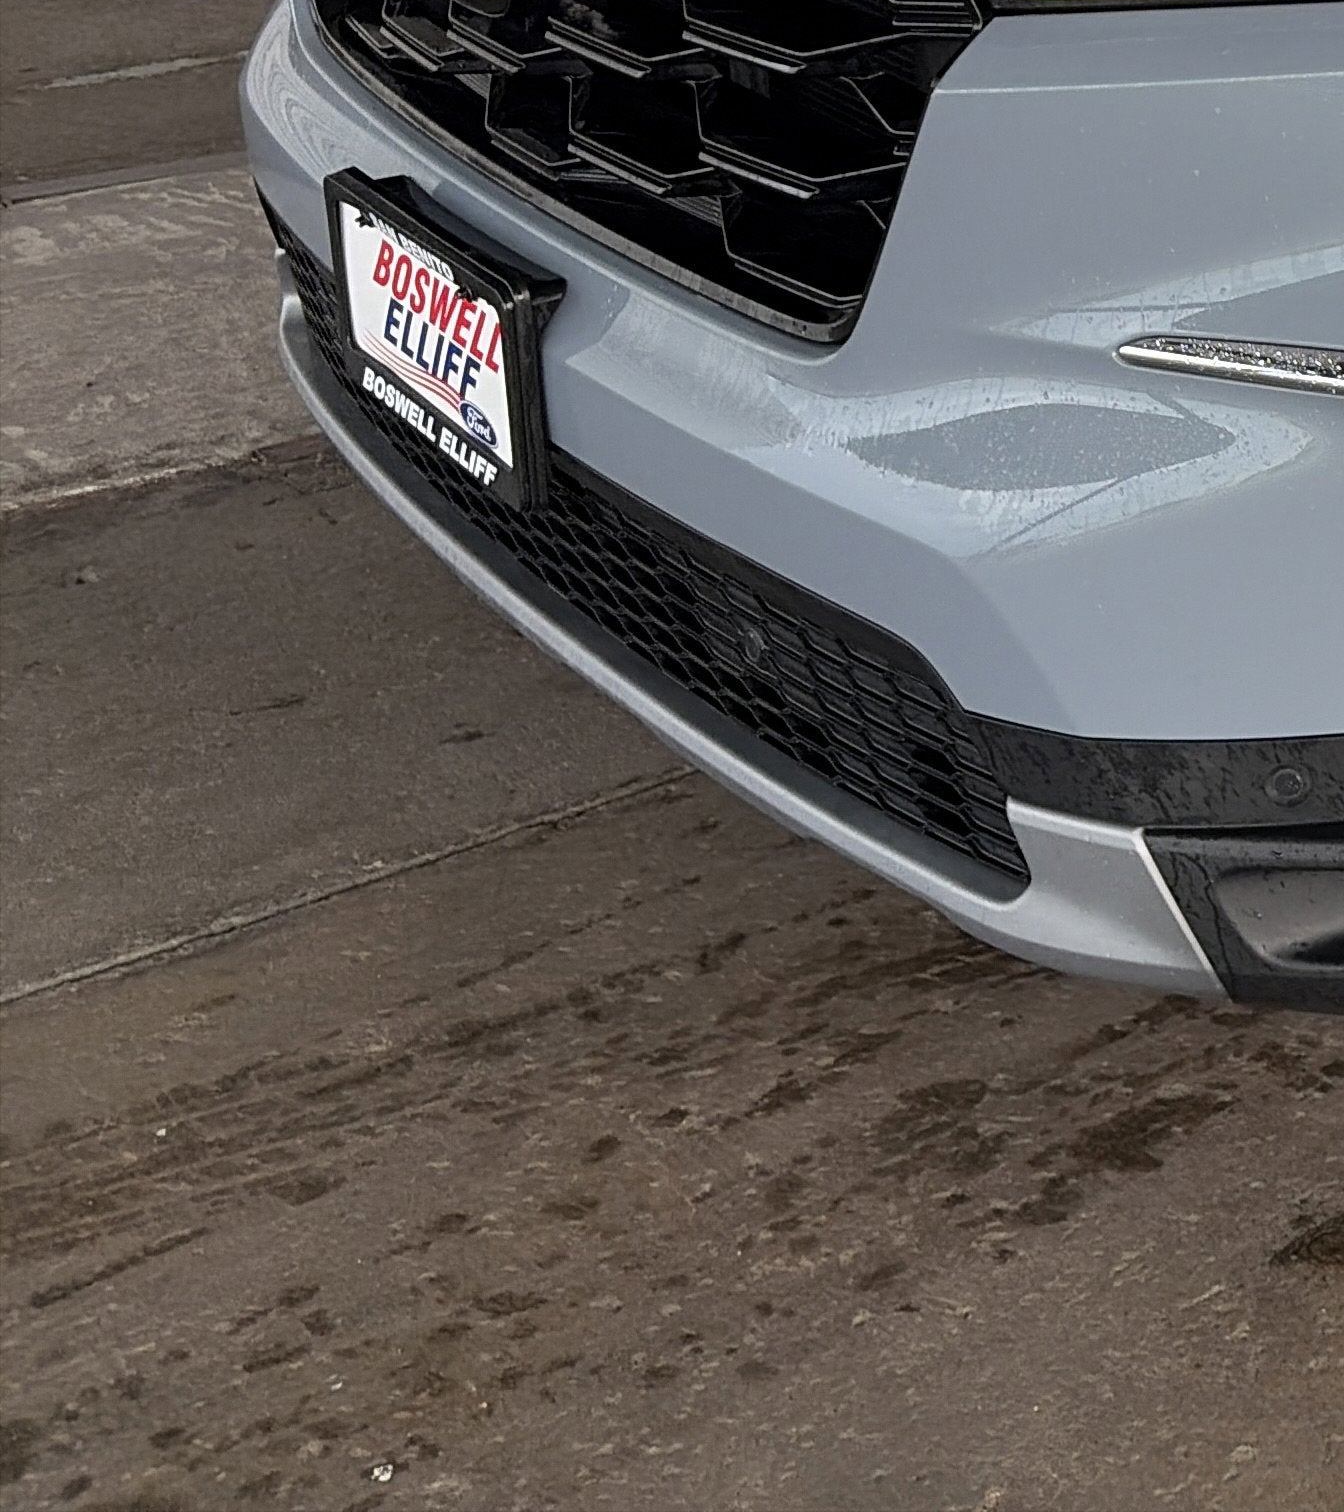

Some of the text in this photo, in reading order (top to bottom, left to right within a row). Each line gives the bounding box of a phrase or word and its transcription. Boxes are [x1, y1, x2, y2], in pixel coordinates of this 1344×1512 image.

[373, 238, 500, 375] BOSWELL
[383, 297, 481, 401] ELLIFF
[362, 366, 498, 486] BOSWELL ELLIFF
